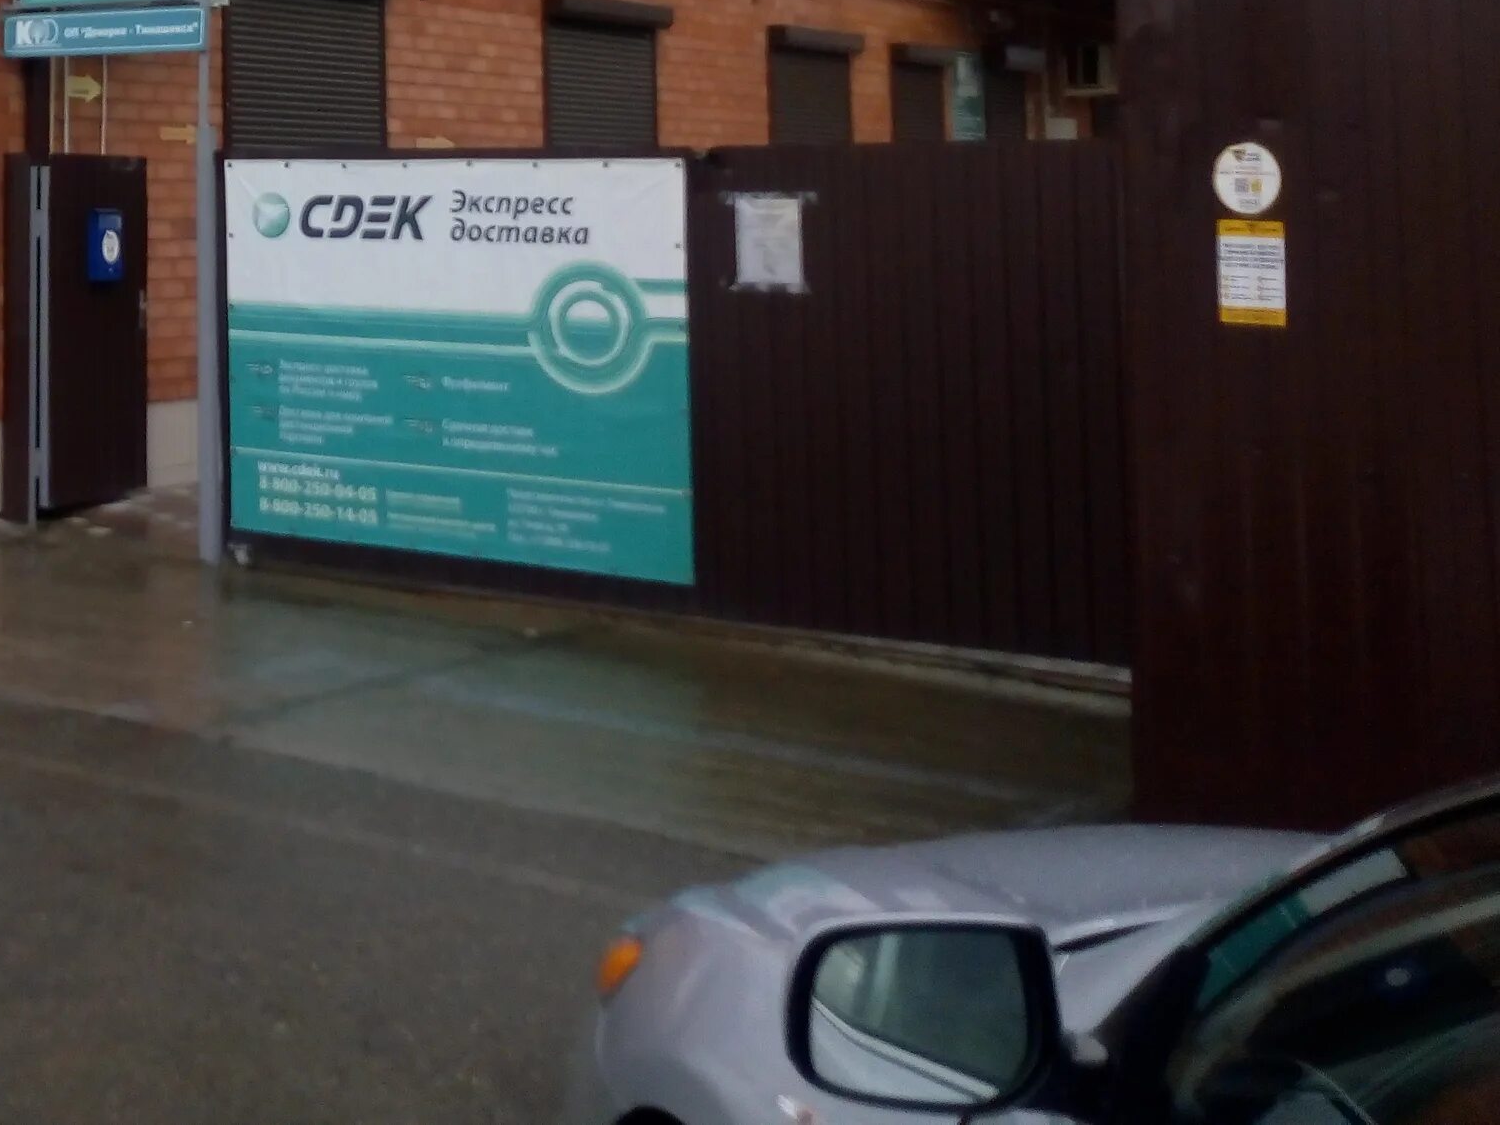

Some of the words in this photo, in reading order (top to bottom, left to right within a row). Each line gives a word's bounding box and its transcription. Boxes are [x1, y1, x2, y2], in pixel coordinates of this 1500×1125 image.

[300, 194, 434, 240] CDEK
[449, 189, 574, 217] Экспресс
[449, 216, 590, 246] доставка
